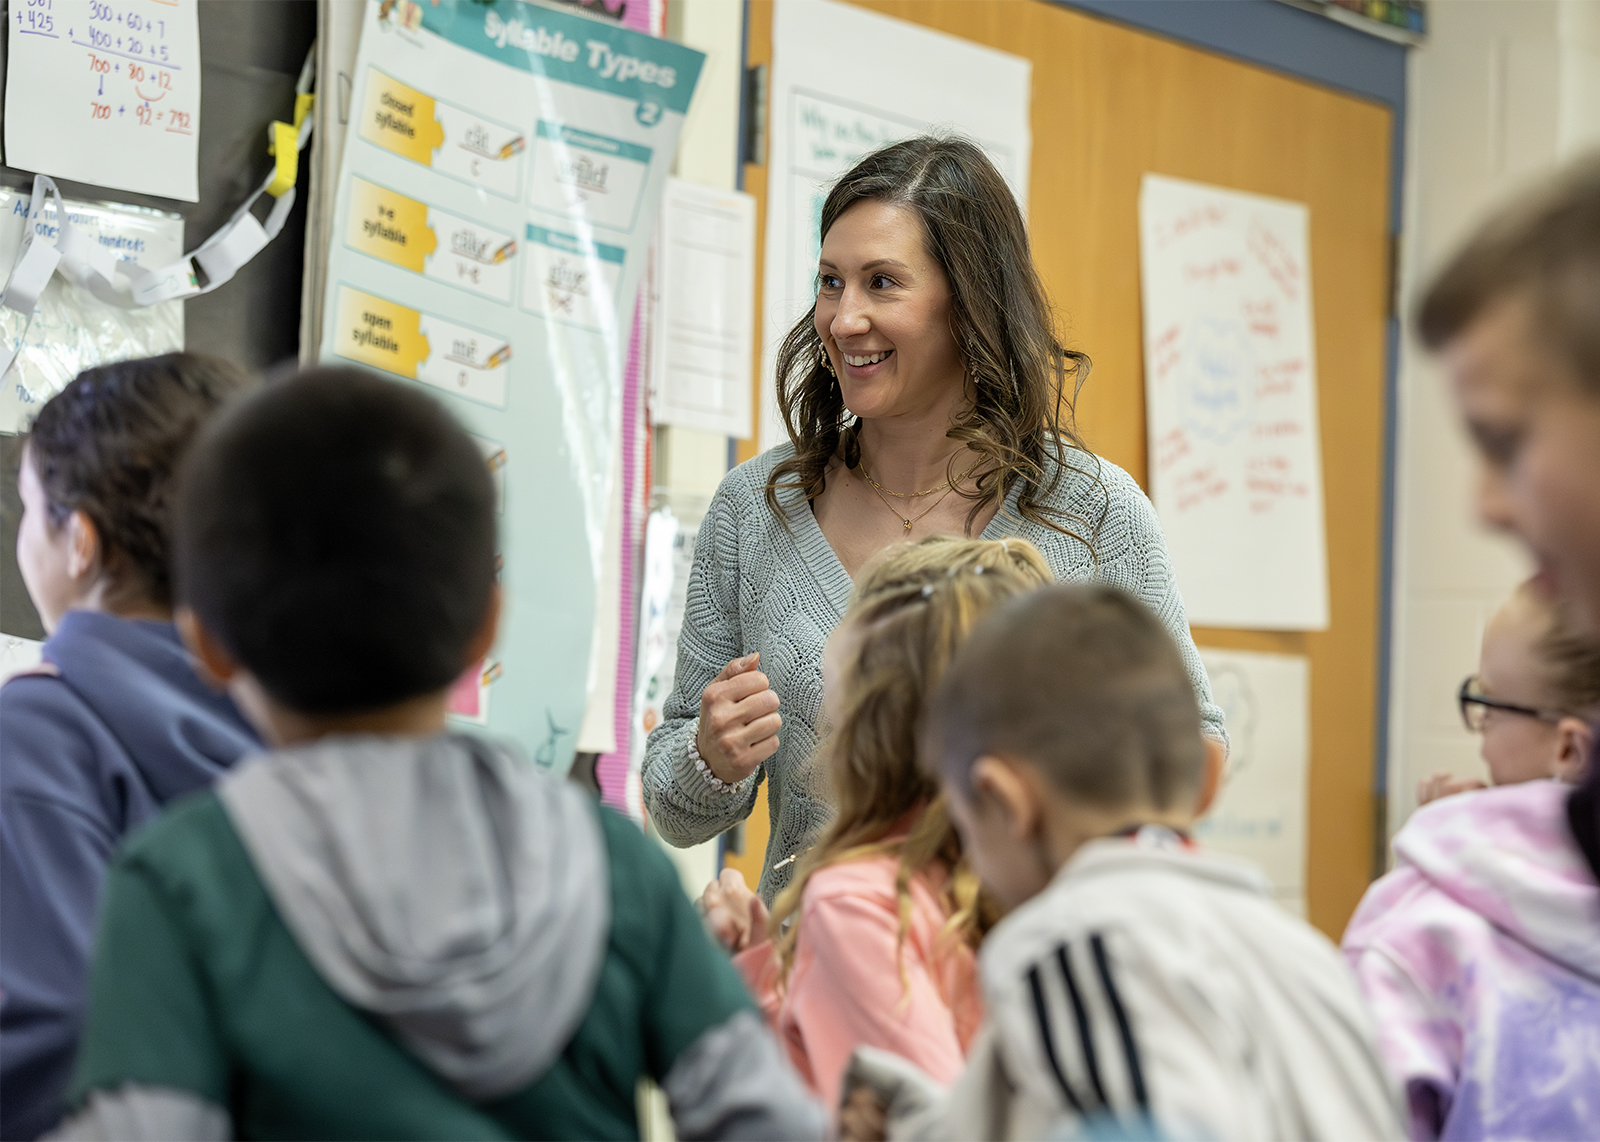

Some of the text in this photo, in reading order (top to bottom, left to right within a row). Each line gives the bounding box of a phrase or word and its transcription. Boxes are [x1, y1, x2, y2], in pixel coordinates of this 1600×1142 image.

[28, 10, 54, 32] 425
[89, 0, 113, 21] 300
[127, 12, 143, 31] 60
[157, 20, 165, 39] 7
[88, 25, 112, 48] 400
[128, 37, 143, 54] 20
[160, 45, 169, 61] 5
[485, 9, 580, 62] Syllable
[586, 39, 677, 89] Types
[87, 53, 110, 73] 700
[128, 62, 145, 82] 80
[158, 71, 173, 91] 12
[90, 102, 111, 120] 700
[136, 105, 152, 126] 92
[169, 109, 190, 128] 792
[639, 102, 658, 123] 2
[98, 231, 145, 253] hundreds
[362, 218, 408, 247] syllable
[362, 310, 393, 331] open
[352, 328, 400, 355] syllable
